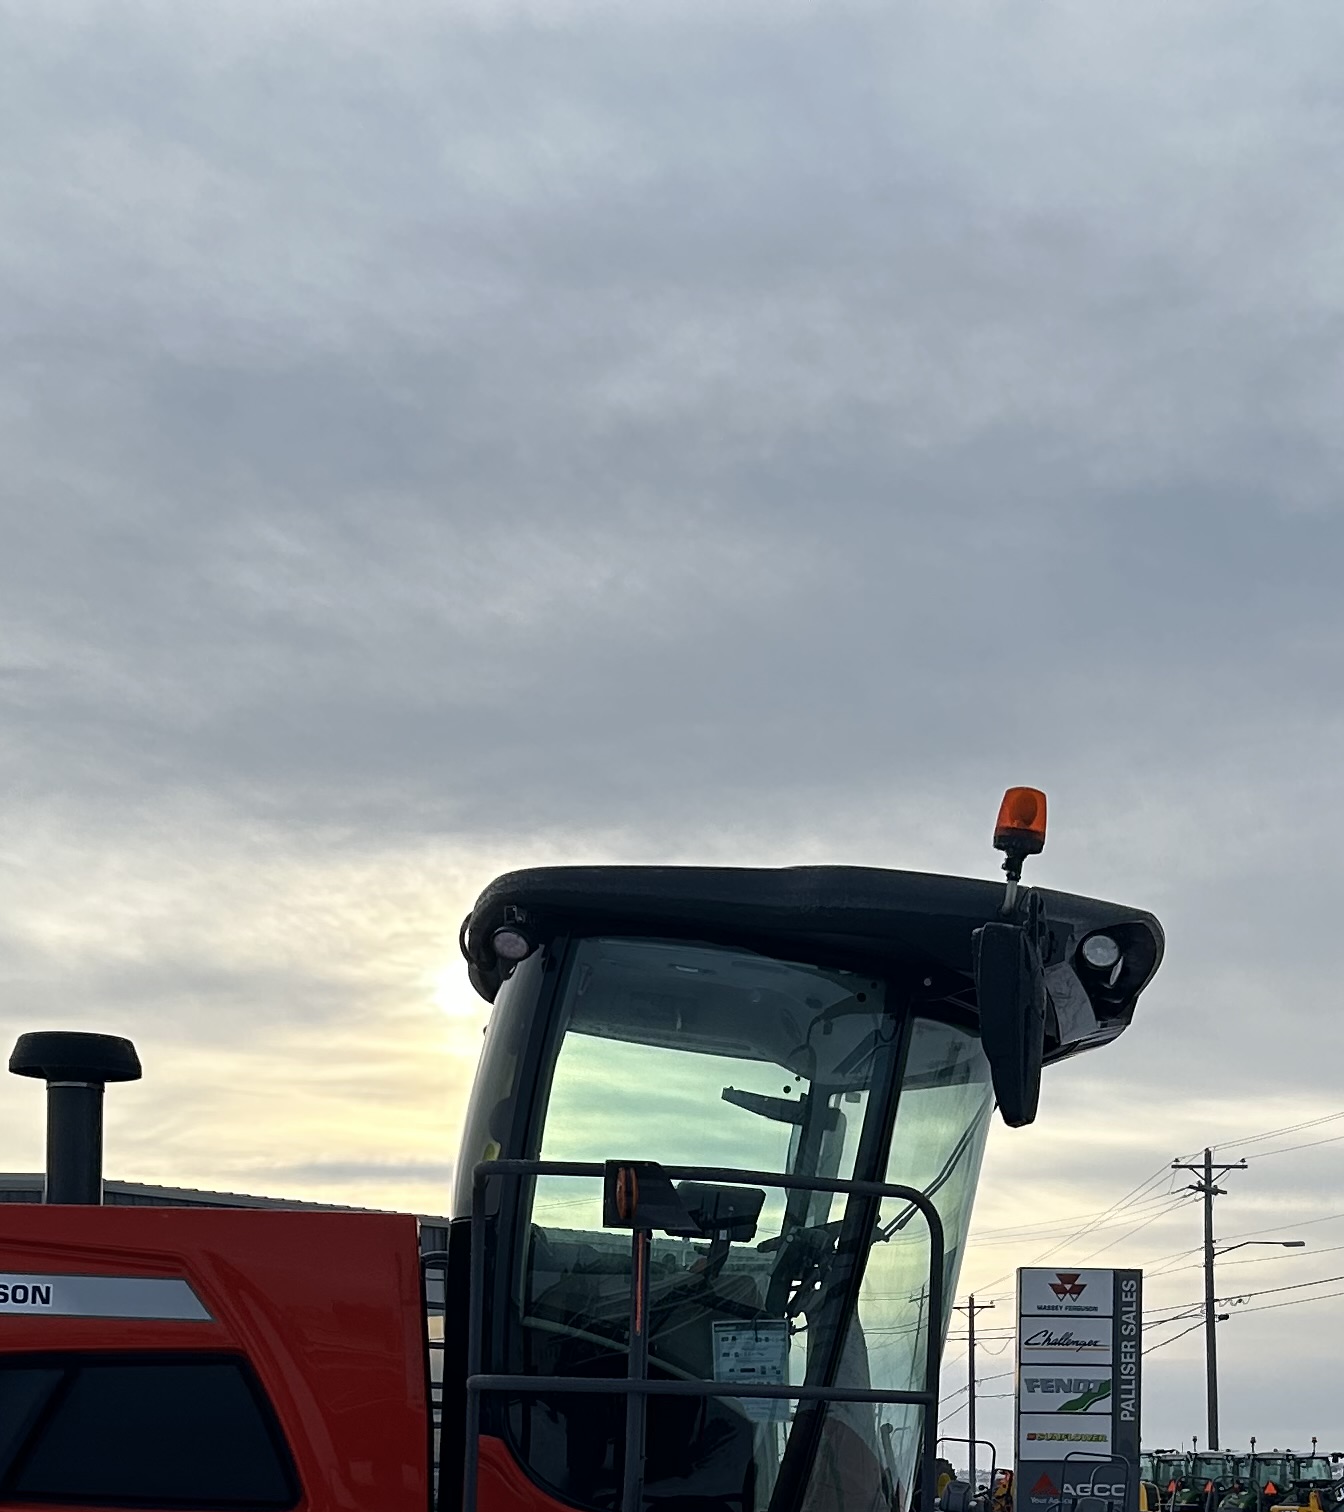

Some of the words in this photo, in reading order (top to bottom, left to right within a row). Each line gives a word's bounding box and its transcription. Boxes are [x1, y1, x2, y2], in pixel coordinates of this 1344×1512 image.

[1121, 1279, 1137, 1336] SALES
[1024, 1329, 1109, 1352] Challenger
[1024, 1378, 1107, 1393] FENDT
[1120, 1340, 1137, 1422] PALLISER
[1035, 1432, 1108, 1442] SUNFLOWER
